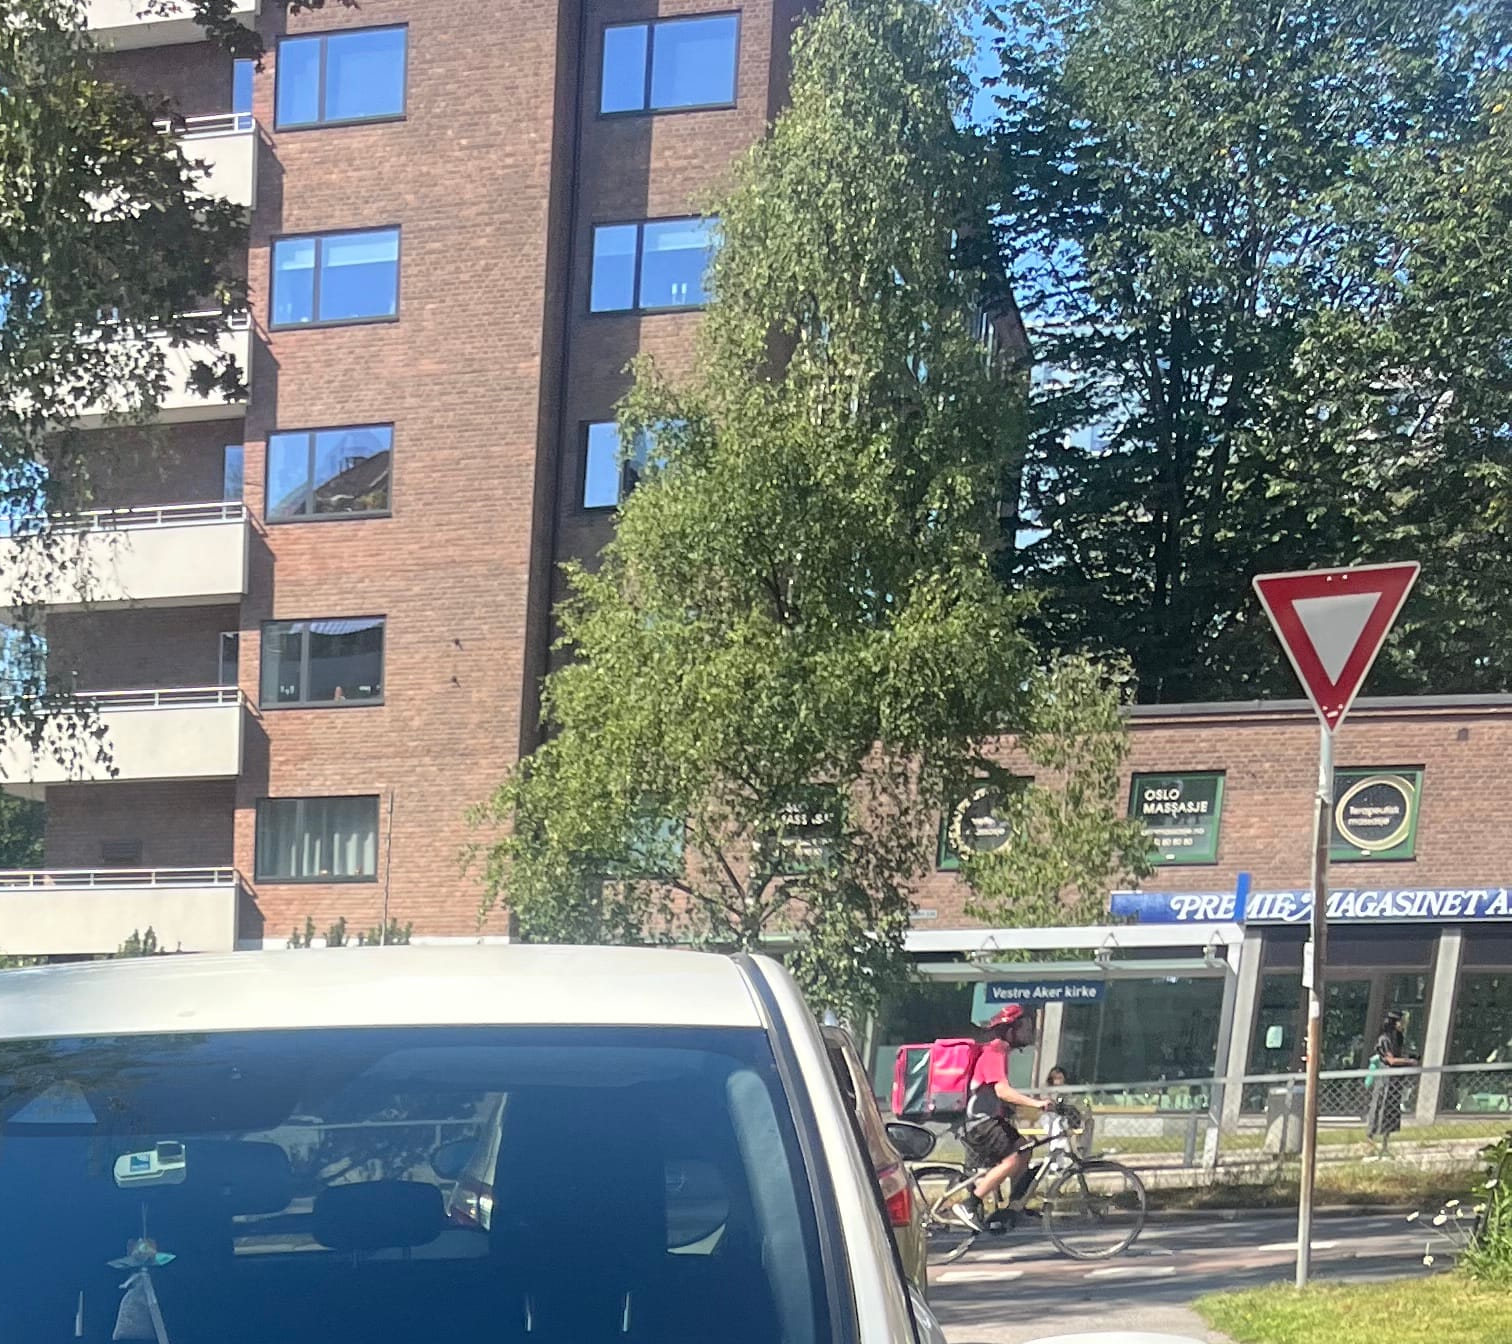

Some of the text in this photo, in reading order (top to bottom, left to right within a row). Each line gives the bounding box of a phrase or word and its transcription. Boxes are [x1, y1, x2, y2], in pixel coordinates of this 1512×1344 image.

[1144, 788, 1180, 801] OSLO
[1143, 801, 1208, 814] MASSASJE
[992, 985, 1097, 999] Vestre Aker kirke
